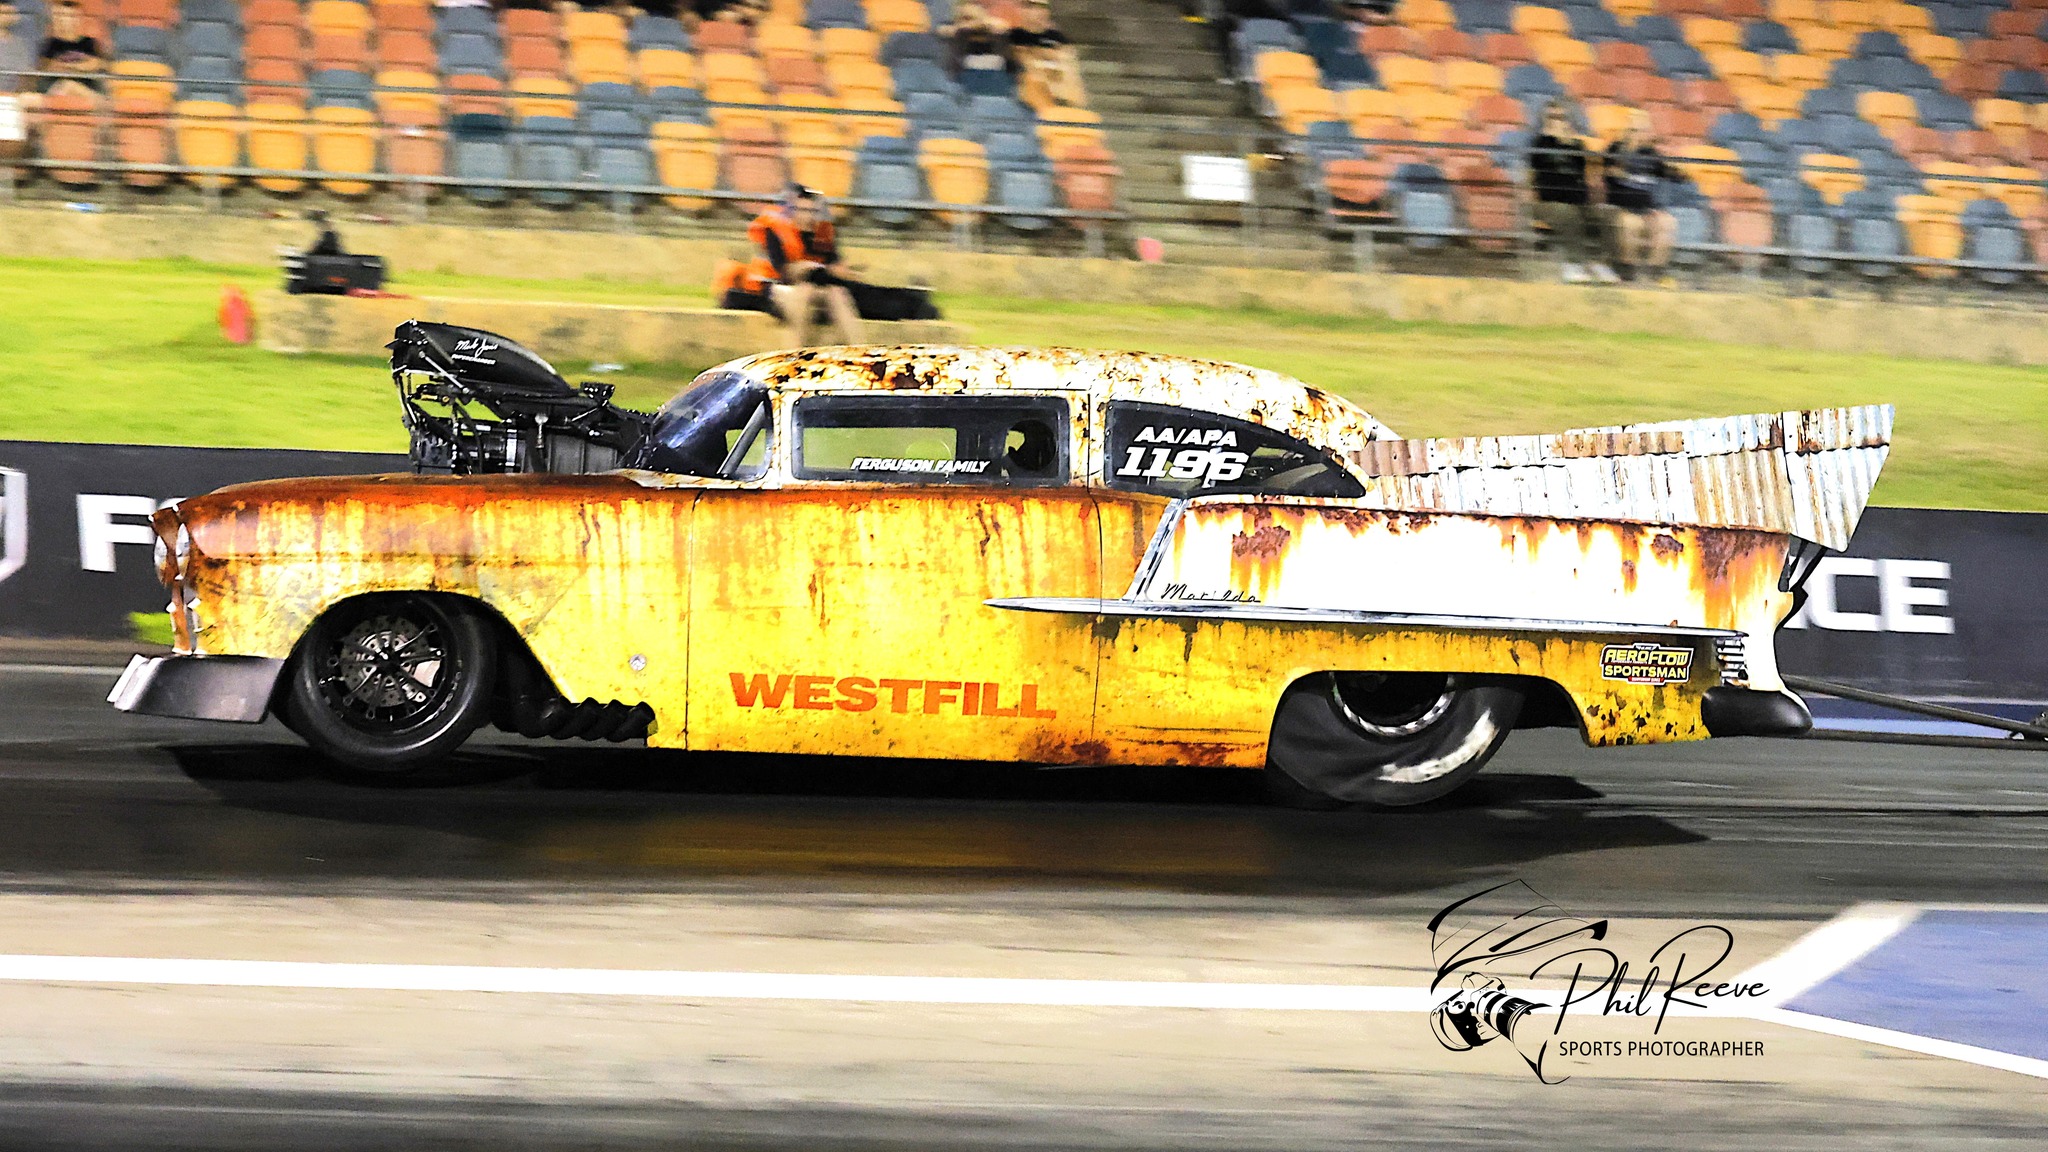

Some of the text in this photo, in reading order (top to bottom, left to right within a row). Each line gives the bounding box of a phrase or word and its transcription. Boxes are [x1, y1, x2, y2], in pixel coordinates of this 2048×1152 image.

[1133, 426, 1238, 447] AA/APA
[850, 457, 990, 473] FERGUSON FAMILY
[1116, 446, 1250, 482] 1196
[1604, 649, 1689, 666] AEROFLOW
[1604, 665, 1687, 679] SPORTSMAN
[729, 672, 1057, 719] WESTFILL
